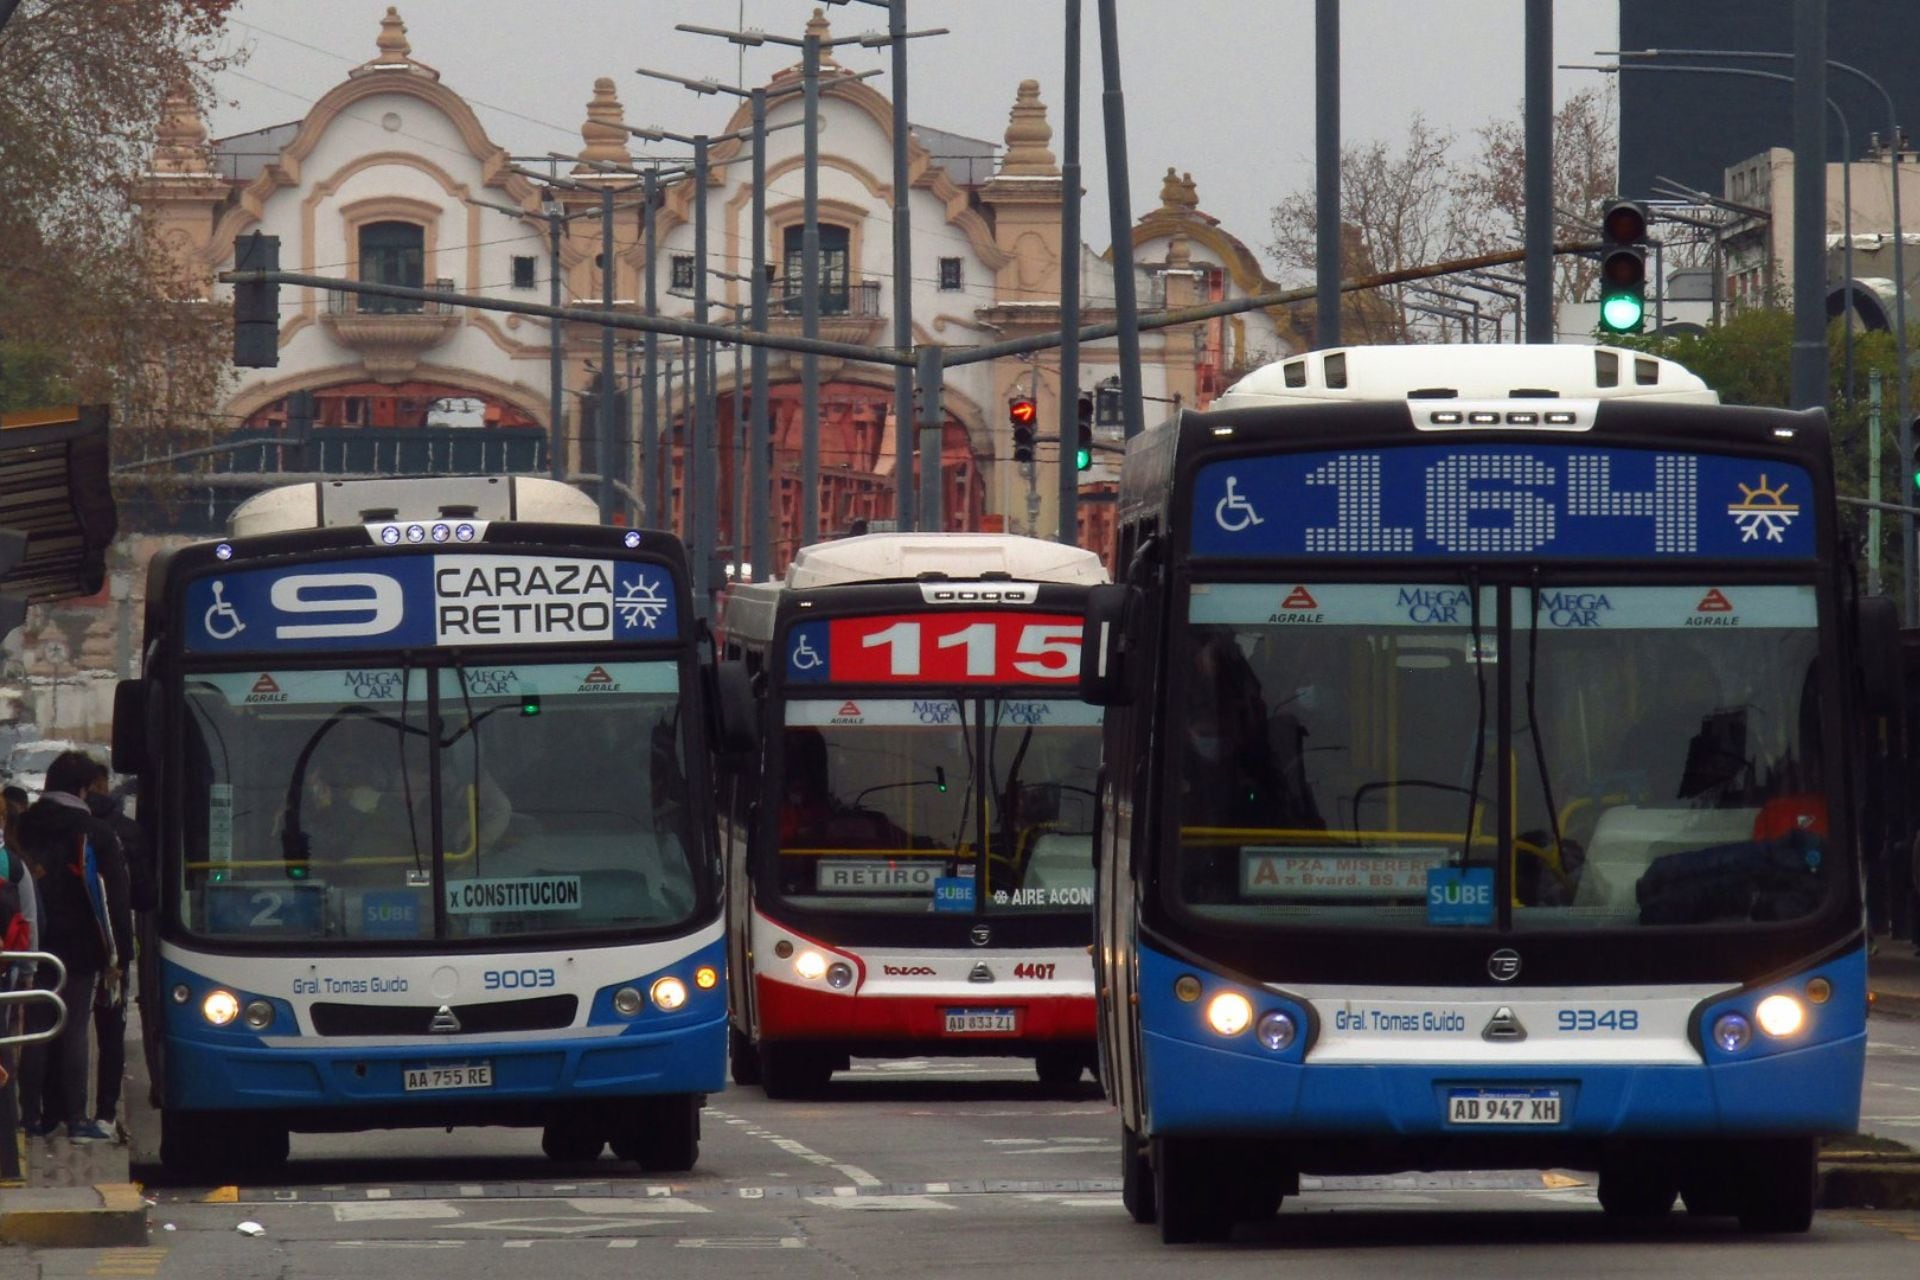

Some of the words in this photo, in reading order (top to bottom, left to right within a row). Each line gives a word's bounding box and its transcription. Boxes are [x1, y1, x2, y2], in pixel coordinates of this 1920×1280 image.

[1306, 455, 1697, 552] 164
[436, 565, 612, 597] CARAZA
[270, 572, 404, 639] 9
[1398, 587, 1471, 607] MEGA
[1537, 592, 1613, 612] MEGA
[440, 602, 610, 635] RETIRO
[1268, 613, 1324, 623] AGRALE
[1409, 605, 1459, 623] CAR
[1550, 609, 1601, 627] CAR
[1685, 616, 1740, 626] AGRALE
[862, 622, 1083, 678] 115
[344, 671, 402, 686] MEGA
[464, 670, 518, 684] MEGA
[355, 684, 394, 699] CAR
[472, 682, 510, 694] CAR
[577, 684, 621, 692] AGRALE
[245, 693, 288, 703] AGRALE
[913, 701, 959, 713] MEGA
[921, 712, 951, 723] CAR
[1003, 702, 1049, 715] MEGA
[1012, 713, 1043, 724] CAR
[834, 870, 930, 885] RETIRO
[1254, 857, 1279, 886] A
[464, 881, 578, 907] CONSTITUCION
[937, 887, 972, 899] SUBE
[1012, 888, 1045, 905] AIRE
[1430, 885, 1489, 904] SUBE
[249, 892, 283, 927] 2
[367, 906, 414, 921] SUBE
[484, 969, 556, 989] 9003
[1014, 963, 1056, 979] 4407
[293, 979, 320, 994] Gral.
[324, 977, 367, 993] Tomas
[371, 976, 408, 992] Guido
[949, 1016, 965, 1030] AD
[1335, 1010, 1367, 1031] Gral.
[1370, 1011, 1419, 1032] Tomas
[1423, 1010, 1465, 1032] Guido
[1558, 1010, 1639, 1032] 9348
[409, 1072, 428, 1088] AA
[433, 1069, 463, 1086] 755
[468, 1068, 488, 1084] RE
[1455, 1100, 1479, 1119] AD
[1486, 1100, 1523, 1119] 947
[1531, 1100, 1555, 1119] XH
